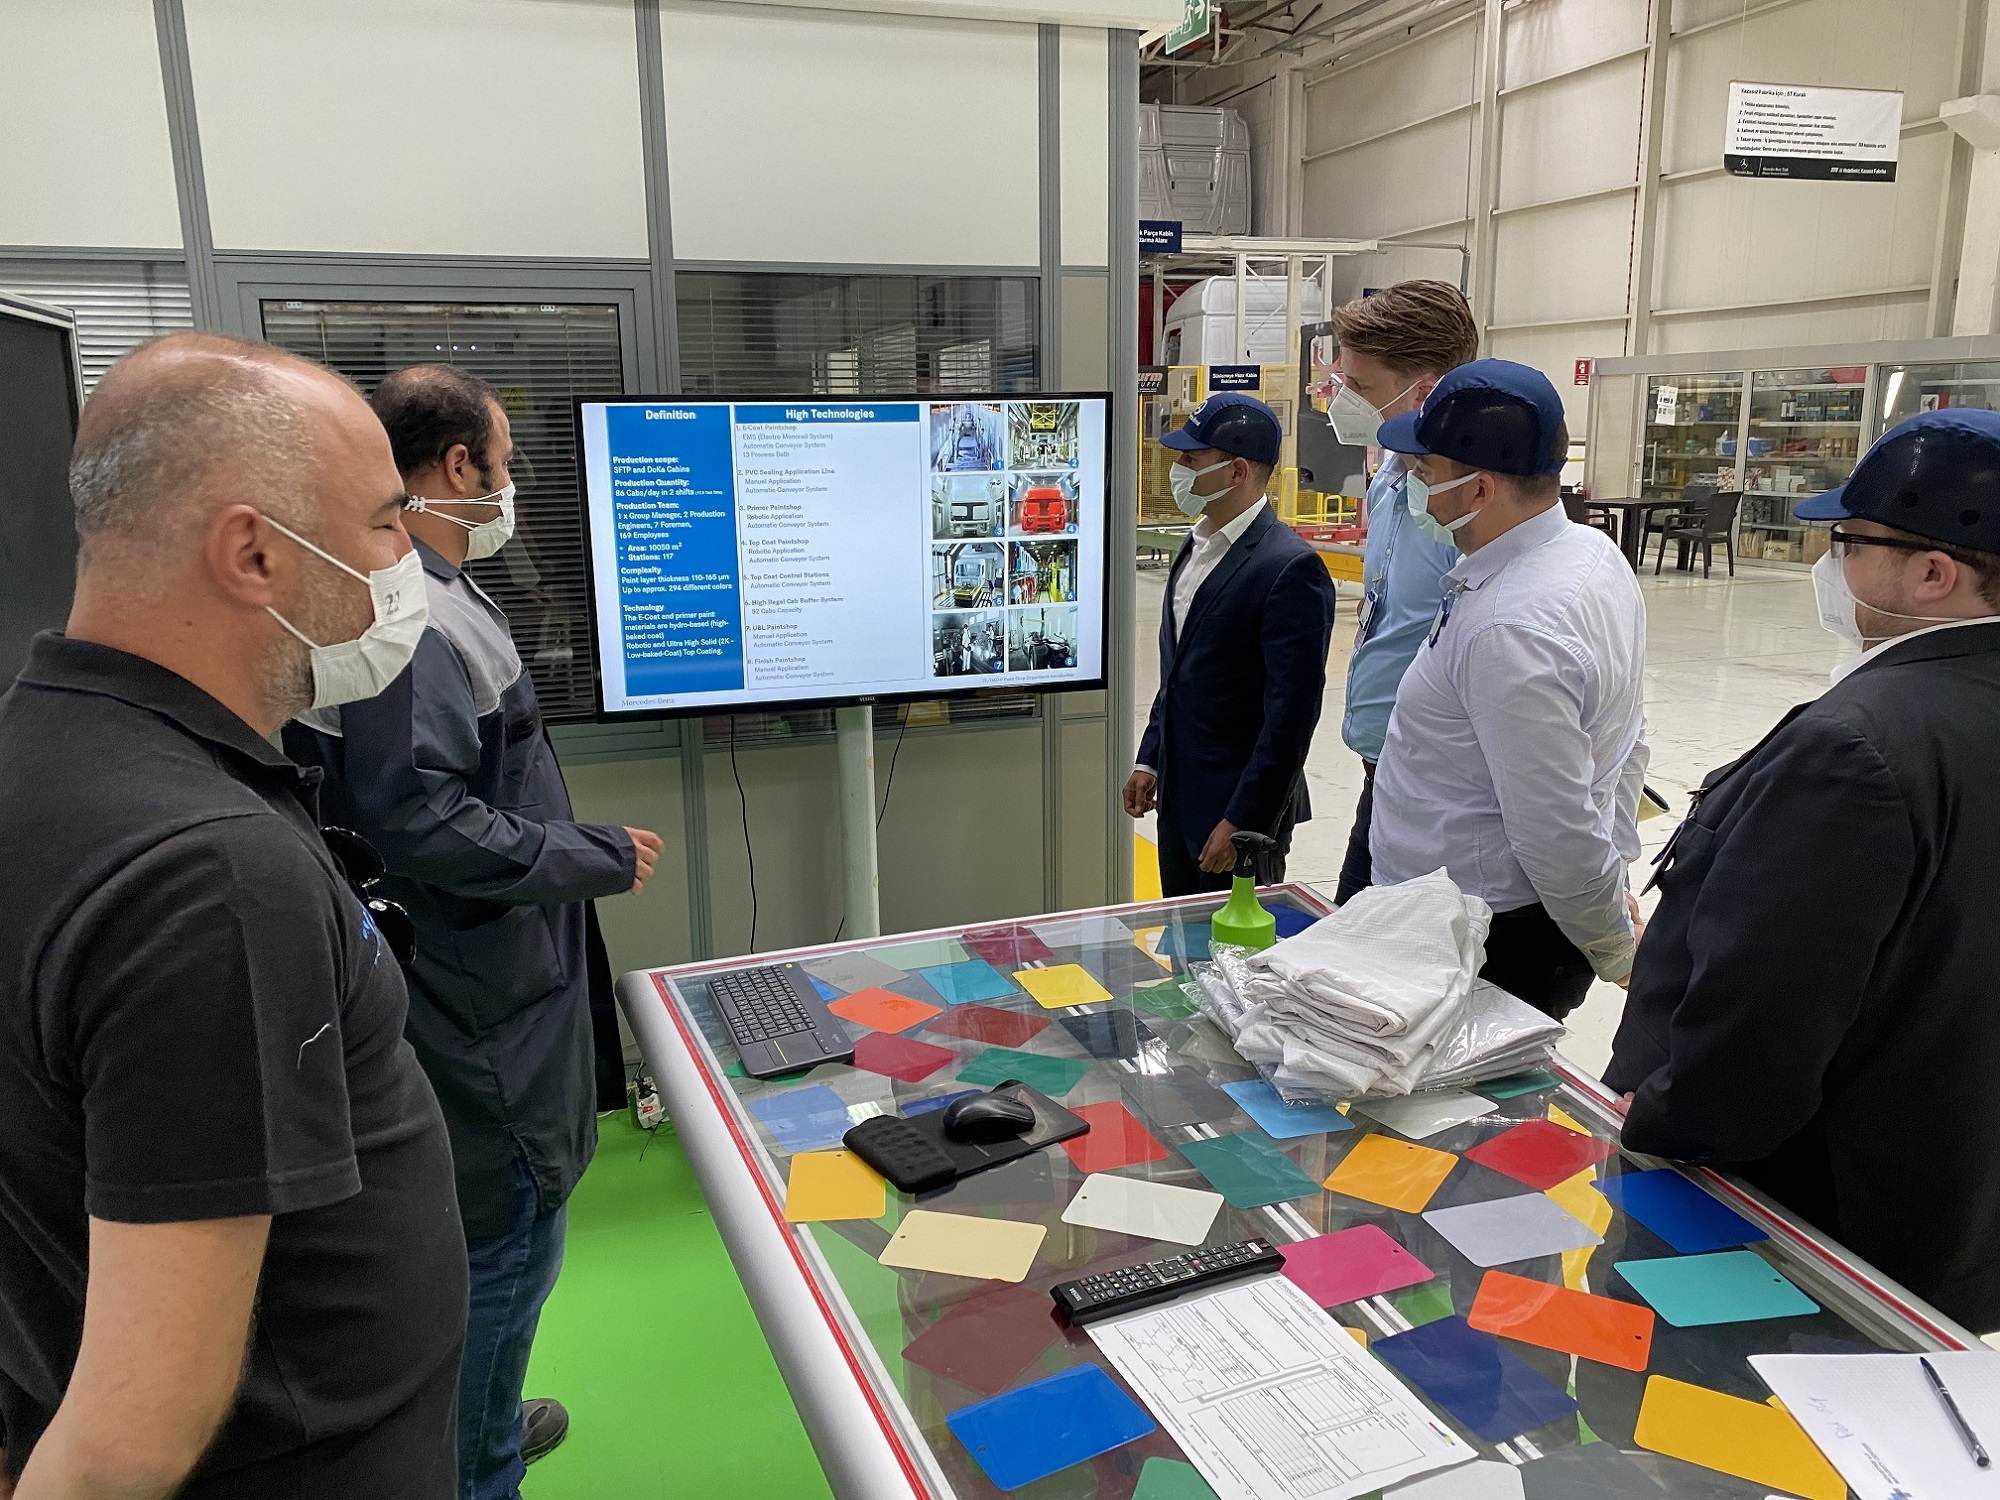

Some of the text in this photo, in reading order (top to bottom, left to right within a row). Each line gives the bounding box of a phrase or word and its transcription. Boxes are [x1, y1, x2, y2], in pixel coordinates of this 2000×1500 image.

[645, 410, 697, 420] Definition
[785, 408, 875, 421] High Technologies
[613, 456, 679, 465] Production scope:
[667, 465, 690, 473] Cabins
[759, 469, 784, 477] Sealing
[784, 468, 820, 476] Application
[615, 479, 690, 488] Production Quantity:
[615, 489, 625, 497] 86
[626, 489, 660, 498] Cabs/day
[661, 488, 668, 496] in
[675, 488, 695, 496] shifts
[616, 502, 656, 510] Production
[629, 512, 650, 520] Group
[689, 510, 726, 518] Production
[633, 531, 669, 540] Employees
[628, 544, 647, 552] Area:
[628, 553, 660, 561] Stations:
[620, 566, 662, 575] Complexity
[621, 576, 639, 584] Paint
[640, 576, 656, 585] layer
[657, 575, 690, 583] thickness
[691, 574, 717, 582] 110-165
[622, 587, 632, 595] Up
[642, 586, 667, 595] approx.
[683, 583, 711, 591] different
[623, 604, 664, 613] Technology
[638, 613, 661, 621] E-Coat
[661, 612, 674, 620] and
[675, 611, 697, 621] primer
[698, 611, 715, 620] paint
[625, 619, 729, 631] materials are hydro-based (high-
[625, 631, 665, 640] baked coat)
[626, 642, 652, 650] Robotic
[667, 640, 683, 648] Ultra
[684, 639, 700, 648] High
[701, 638, 717, 646] Solid
[718, 638, 730, 646] (2K
[683, 649, 695, 657] Top
[696, 647, 723, 656] Coating.
